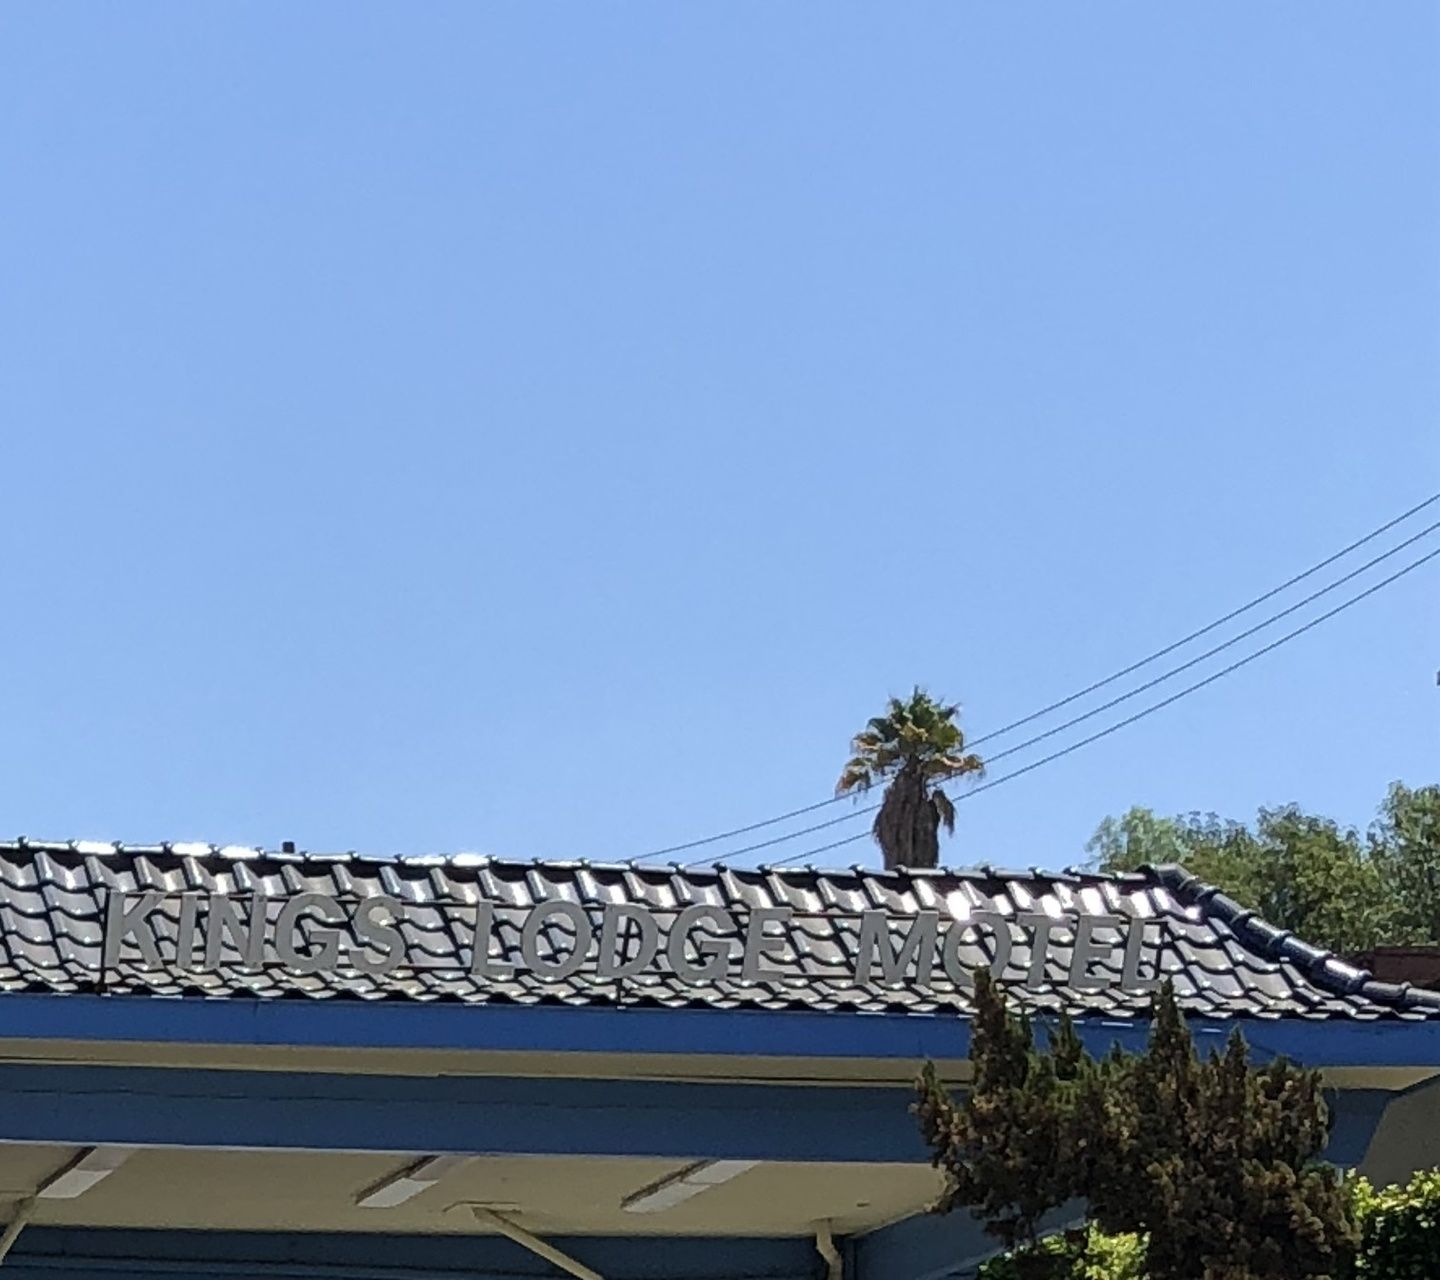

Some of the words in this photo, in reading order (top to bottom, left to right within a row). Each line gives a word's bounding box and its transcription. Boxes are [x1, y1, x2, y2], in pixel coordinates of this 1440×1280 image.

[105, 891, 406, 973] KINGS
[471, 899, 792, 981] LODGE
[854, 909, 1161, 991] MOTEL
